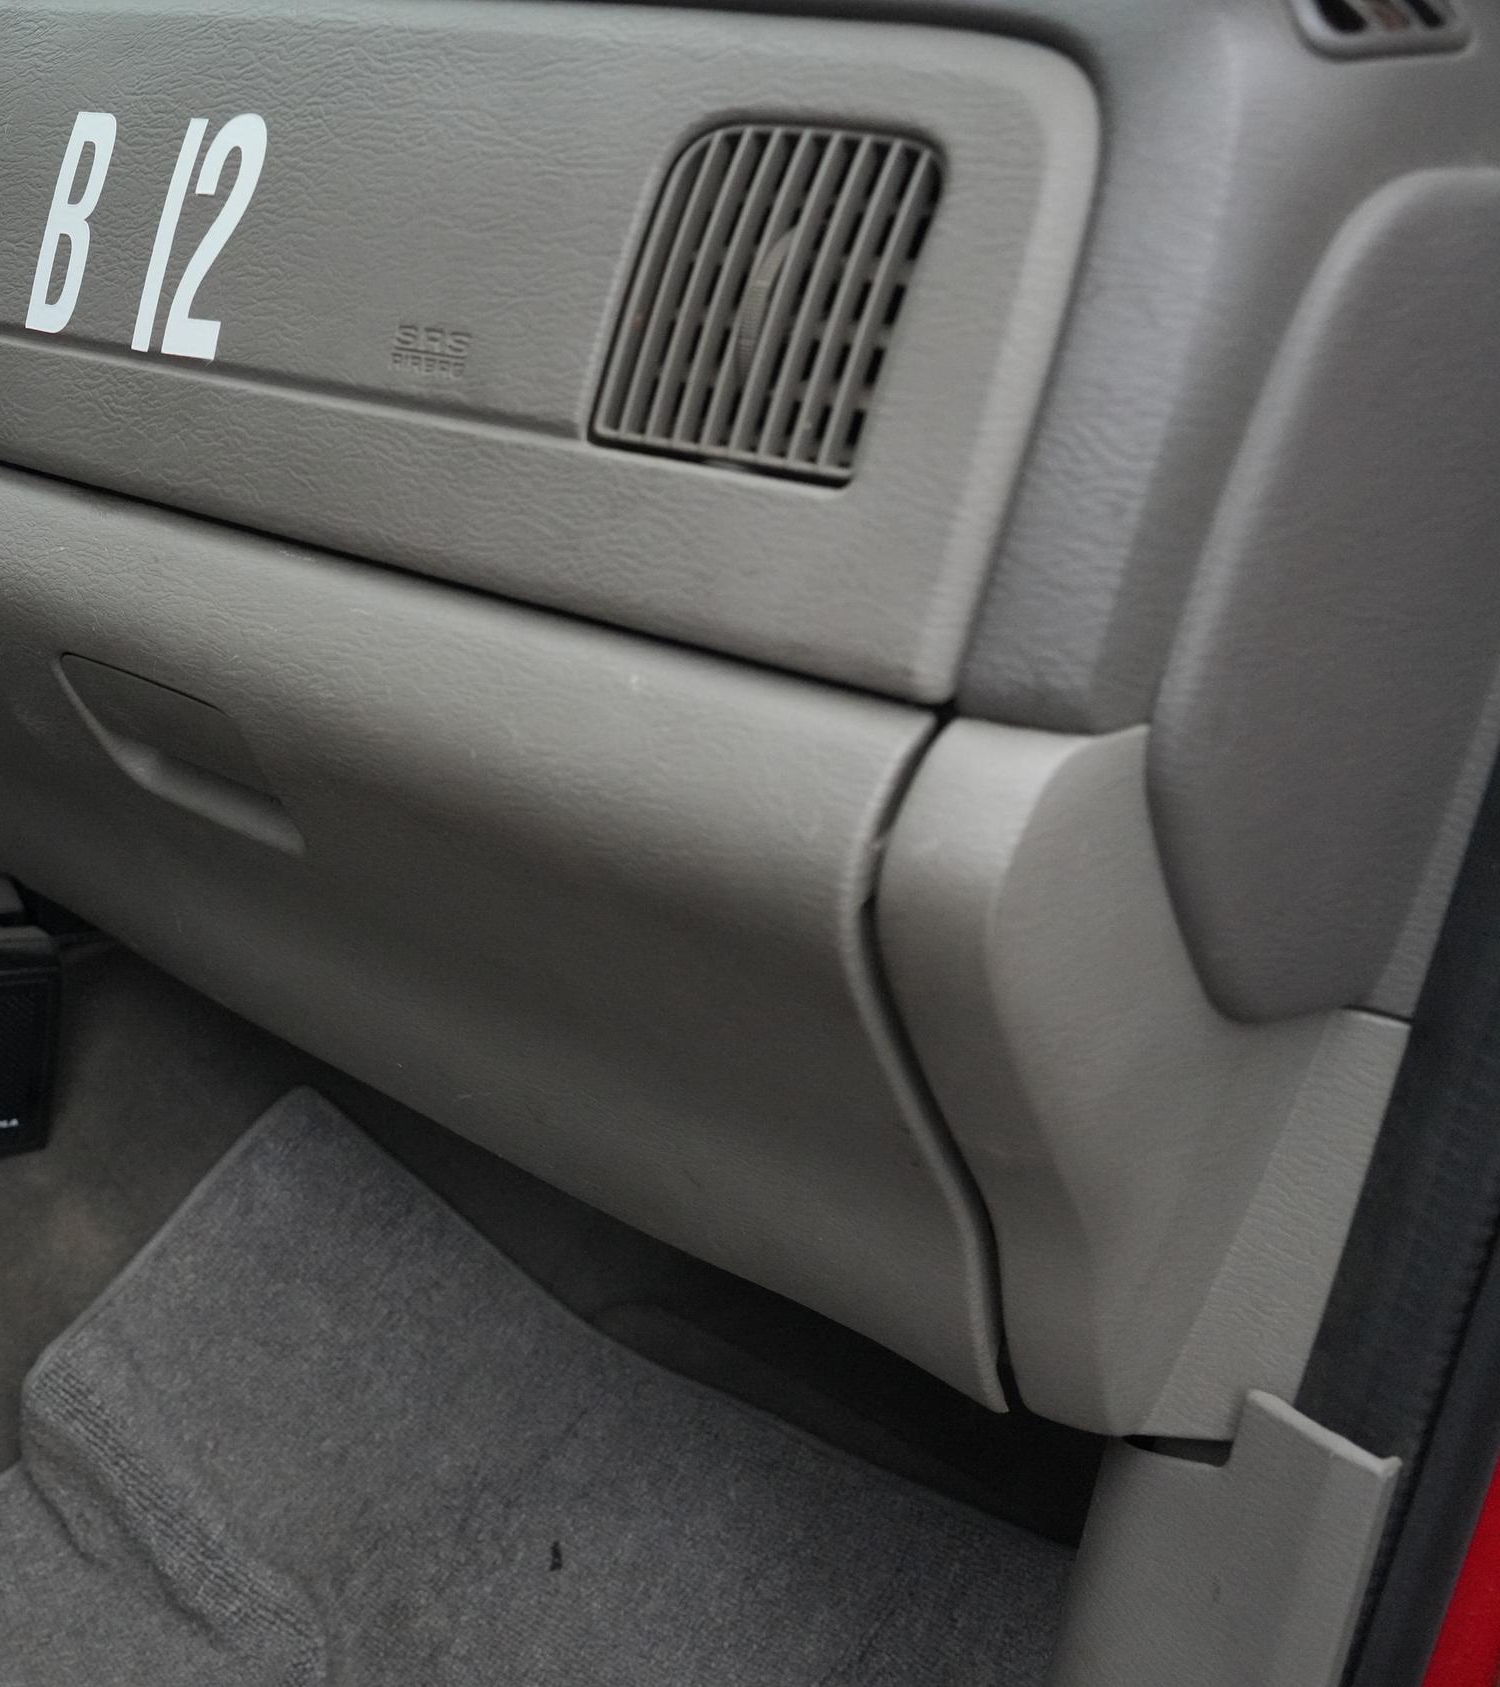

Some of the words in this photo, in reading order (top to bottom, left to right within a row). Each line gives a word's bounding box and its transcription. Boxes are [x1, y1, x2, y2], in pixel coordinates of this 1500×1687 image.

[25, 111, 117, 333] B
[131, 112, 268, 361] 12
[393, 324, 473, 356] SRS
